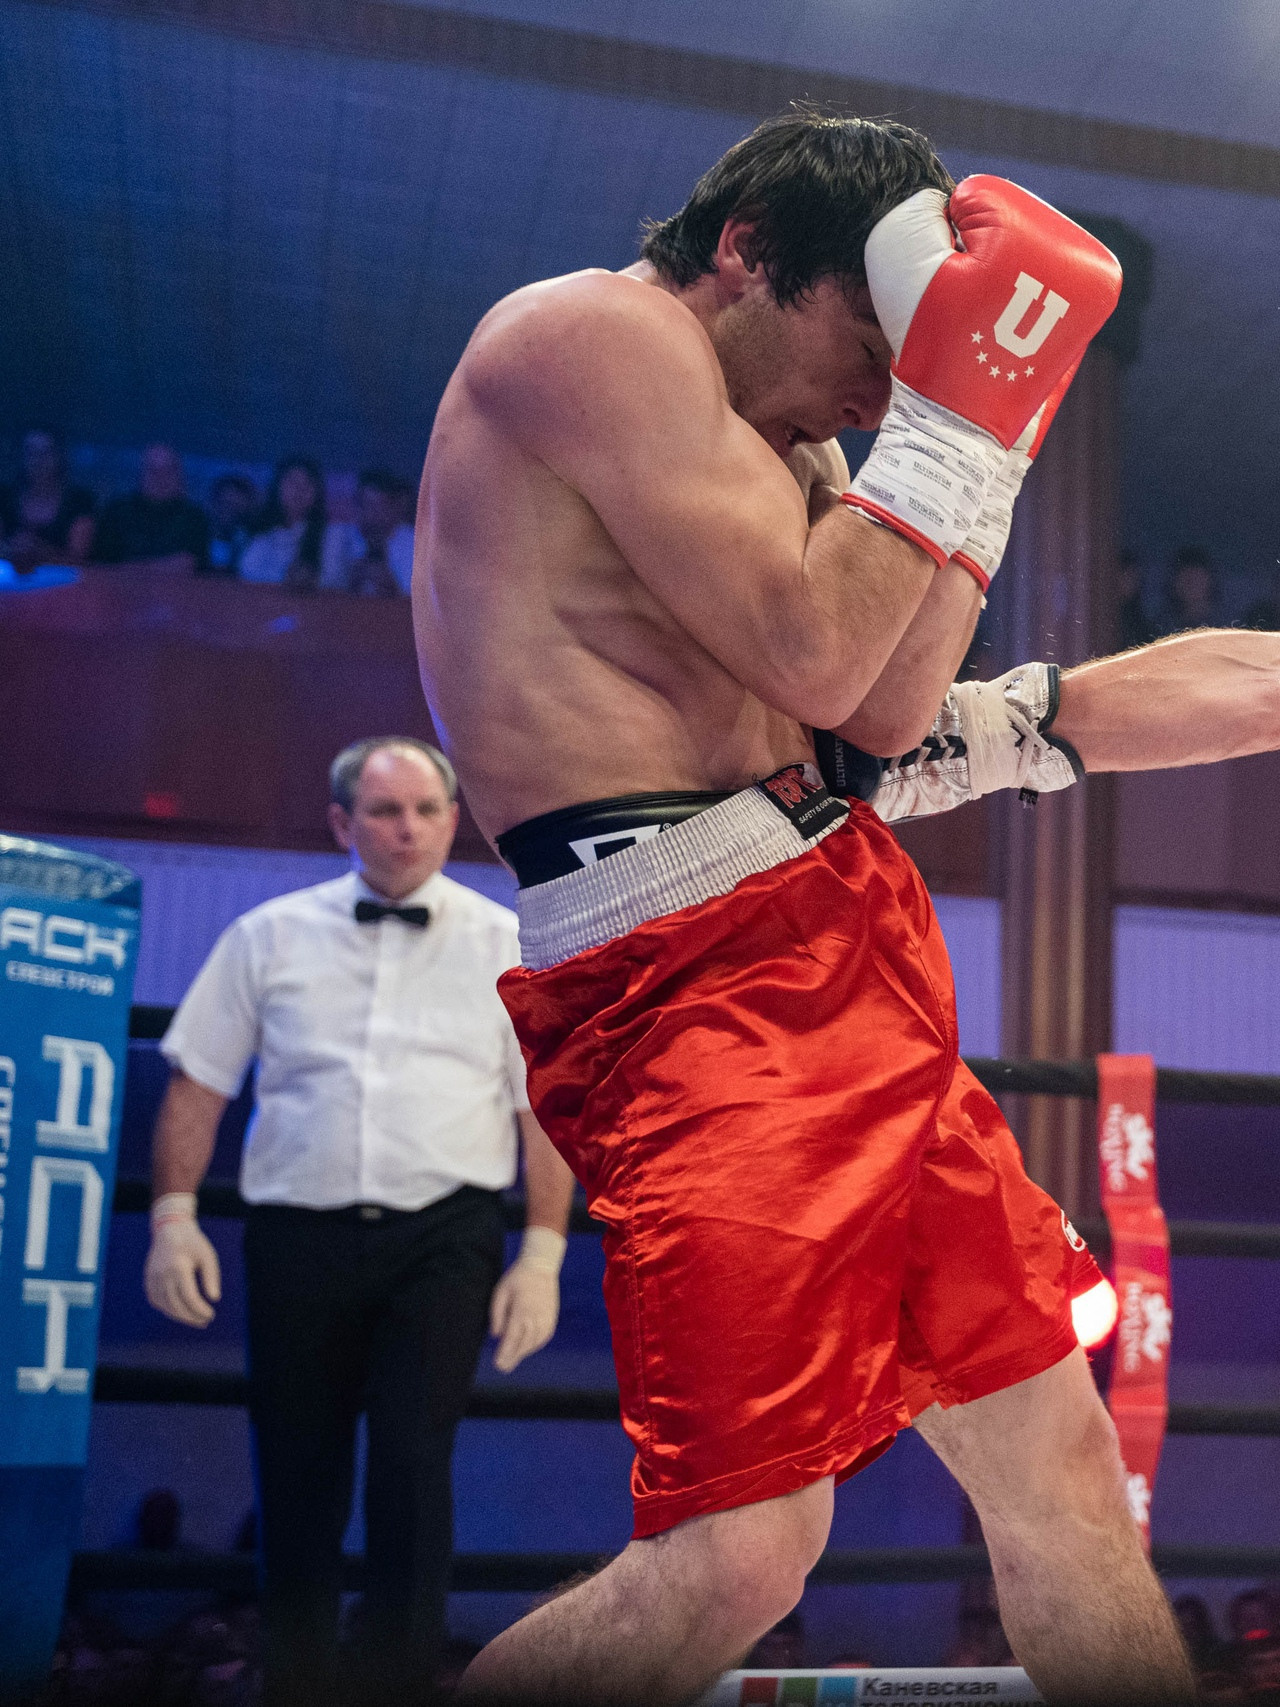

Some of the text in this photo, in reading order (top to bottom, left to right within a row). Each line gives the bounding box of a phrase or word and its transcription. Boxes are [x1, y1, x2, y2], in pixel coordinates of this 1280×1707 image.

[993, 271, 1070, 359] U
[914, 461, 953, 488] ULTIMATUM
[908, 496, 945, 525] ULTIMATUM
[834, 736, 847, 787] ULTIMAT
[798, 809, 818, 824] SAFETY
[861, 1677, 998, 1698] Каневская
